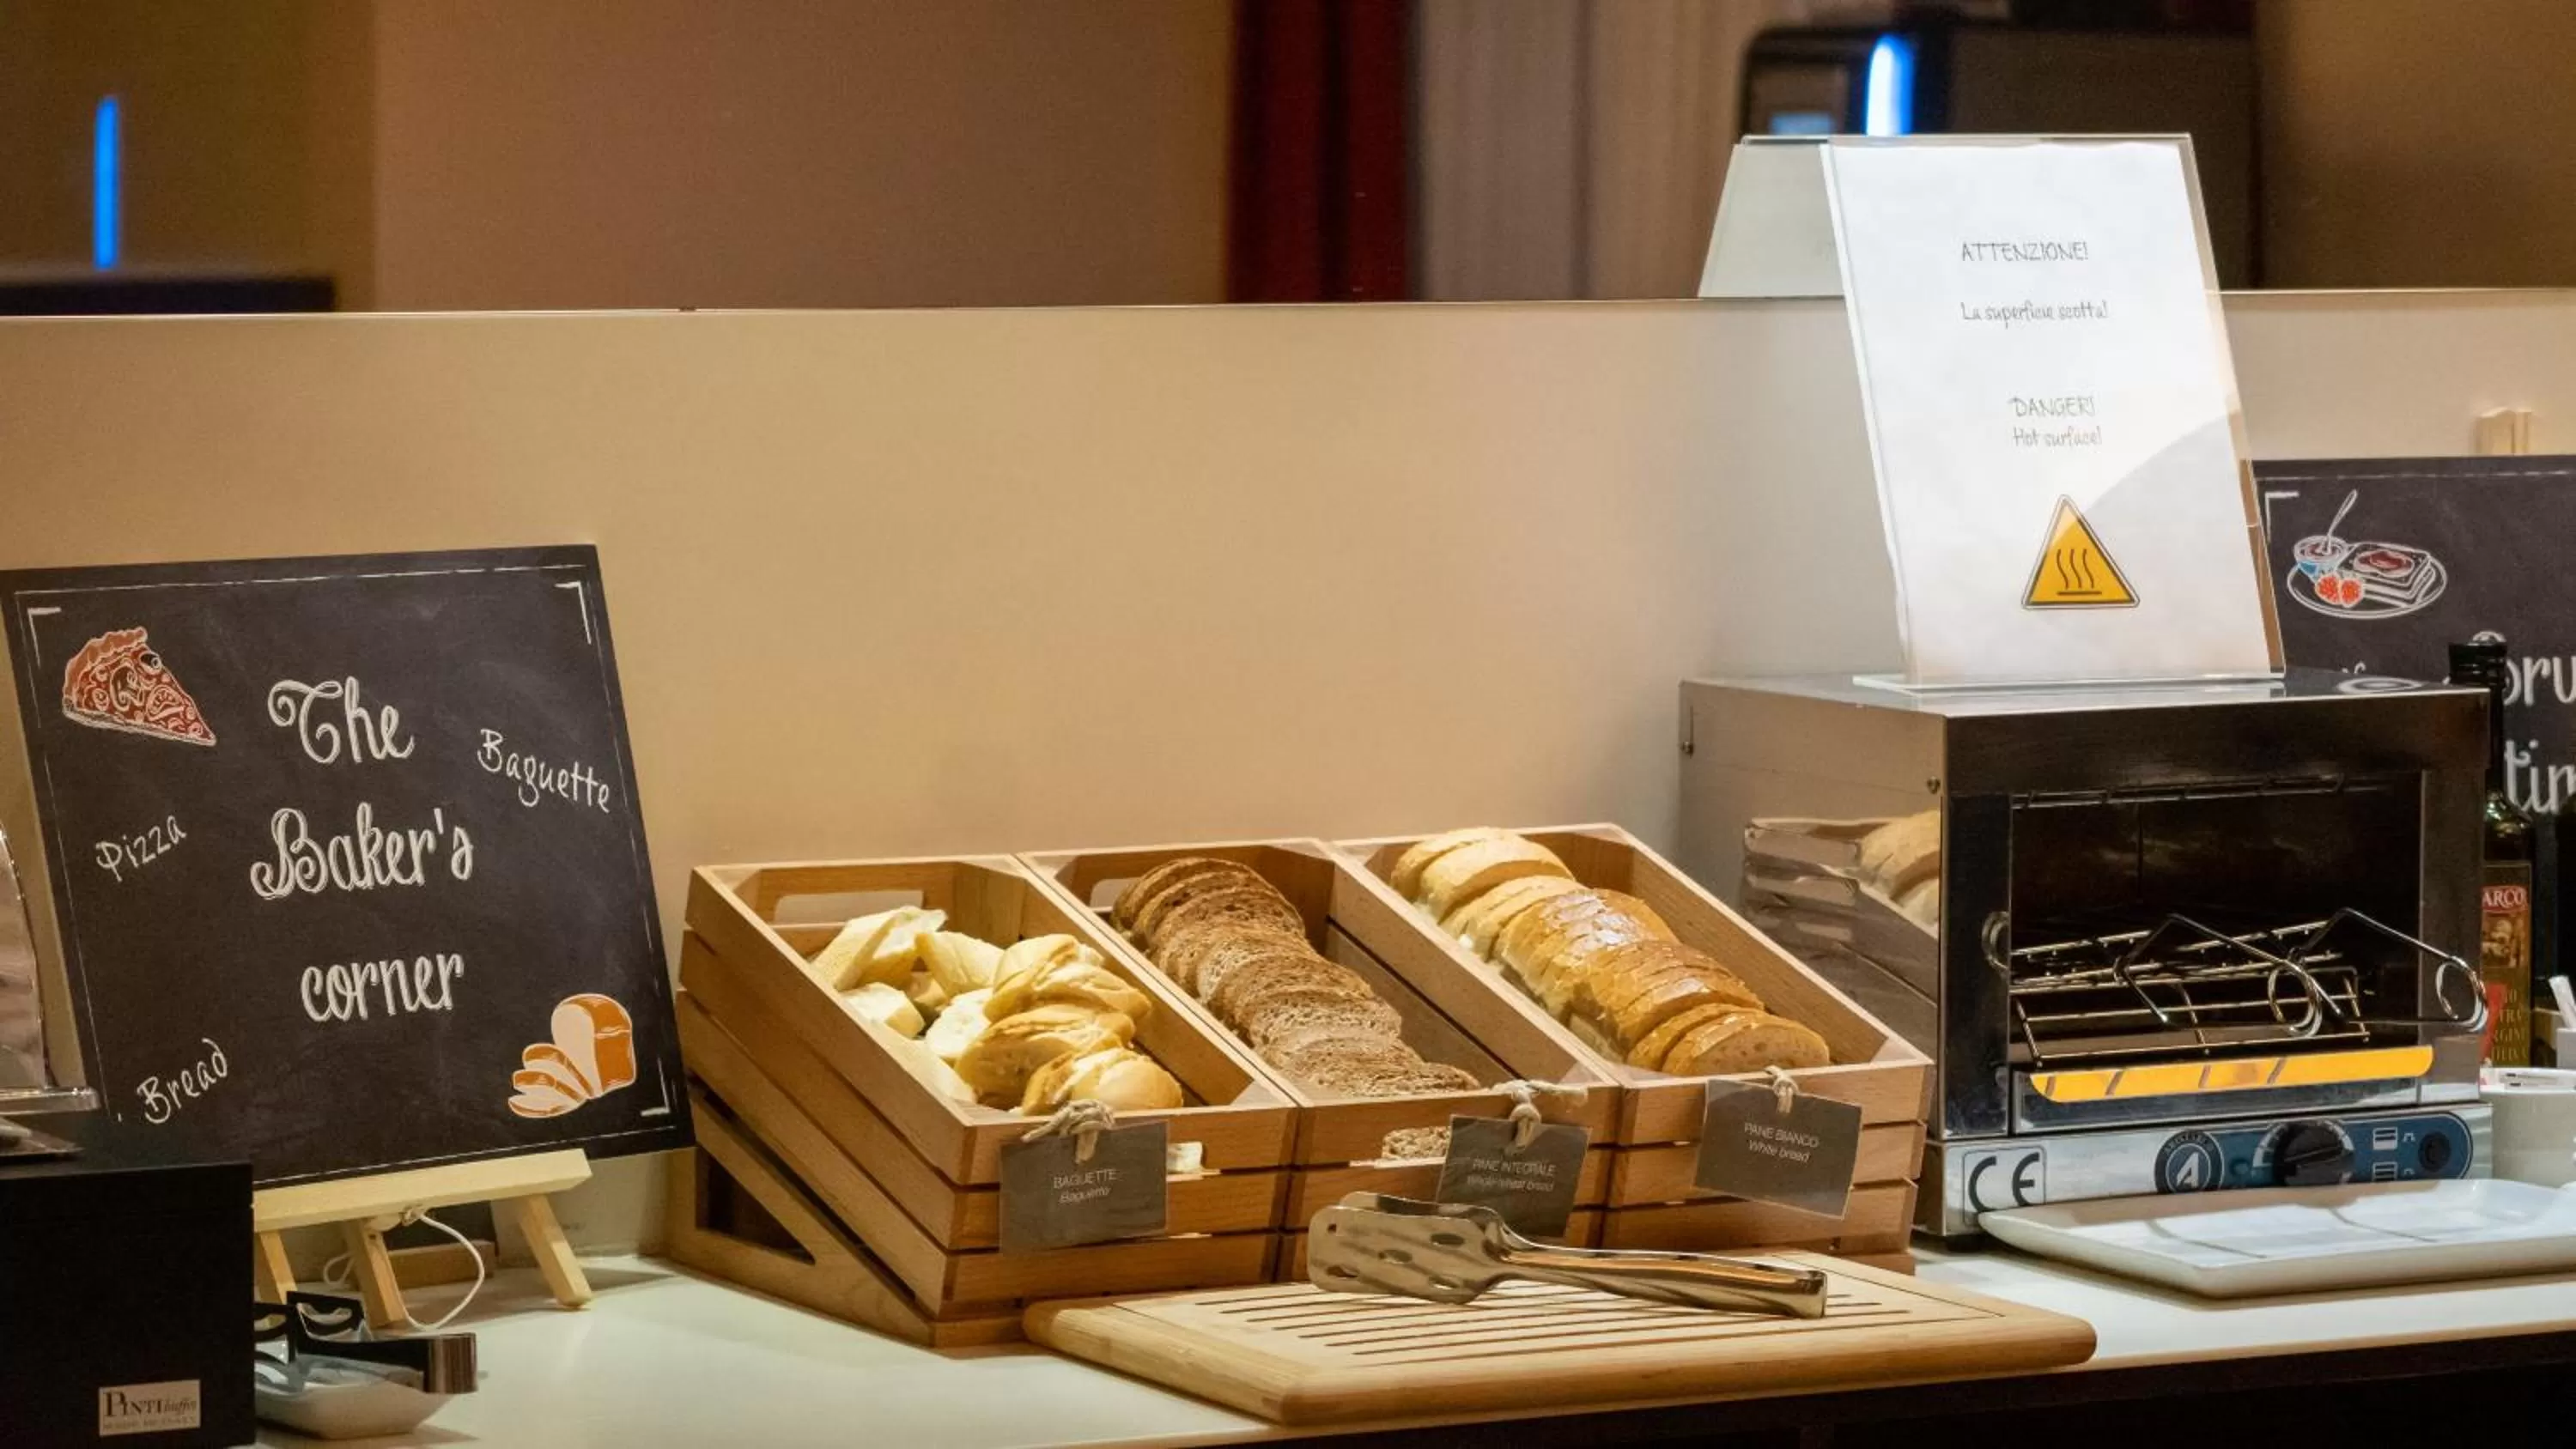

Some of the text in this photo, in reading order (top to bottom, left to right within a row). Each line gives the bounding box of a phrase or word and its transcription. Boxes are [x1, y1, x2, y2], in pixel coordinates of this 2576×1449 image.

[1960, 240, 2089, 262] ATTENZIONE!
[2011, 396, 2096, 417] DANGER!
[2013, 427, 2040, 446] Hot
[268, 676, 415, 763] The
[477, 729, 611, 813] Baguette
[95, 815, 187, 882] Pizza
[250, 803, 473, 899] Baker's
[301, 953, 465, 1022] corner
[137, 1038, 228, 1125] Bread
[1054, 1168, 1118, 1190] BAGUETTE
[102, 1391, 162, 1417] PINTI
